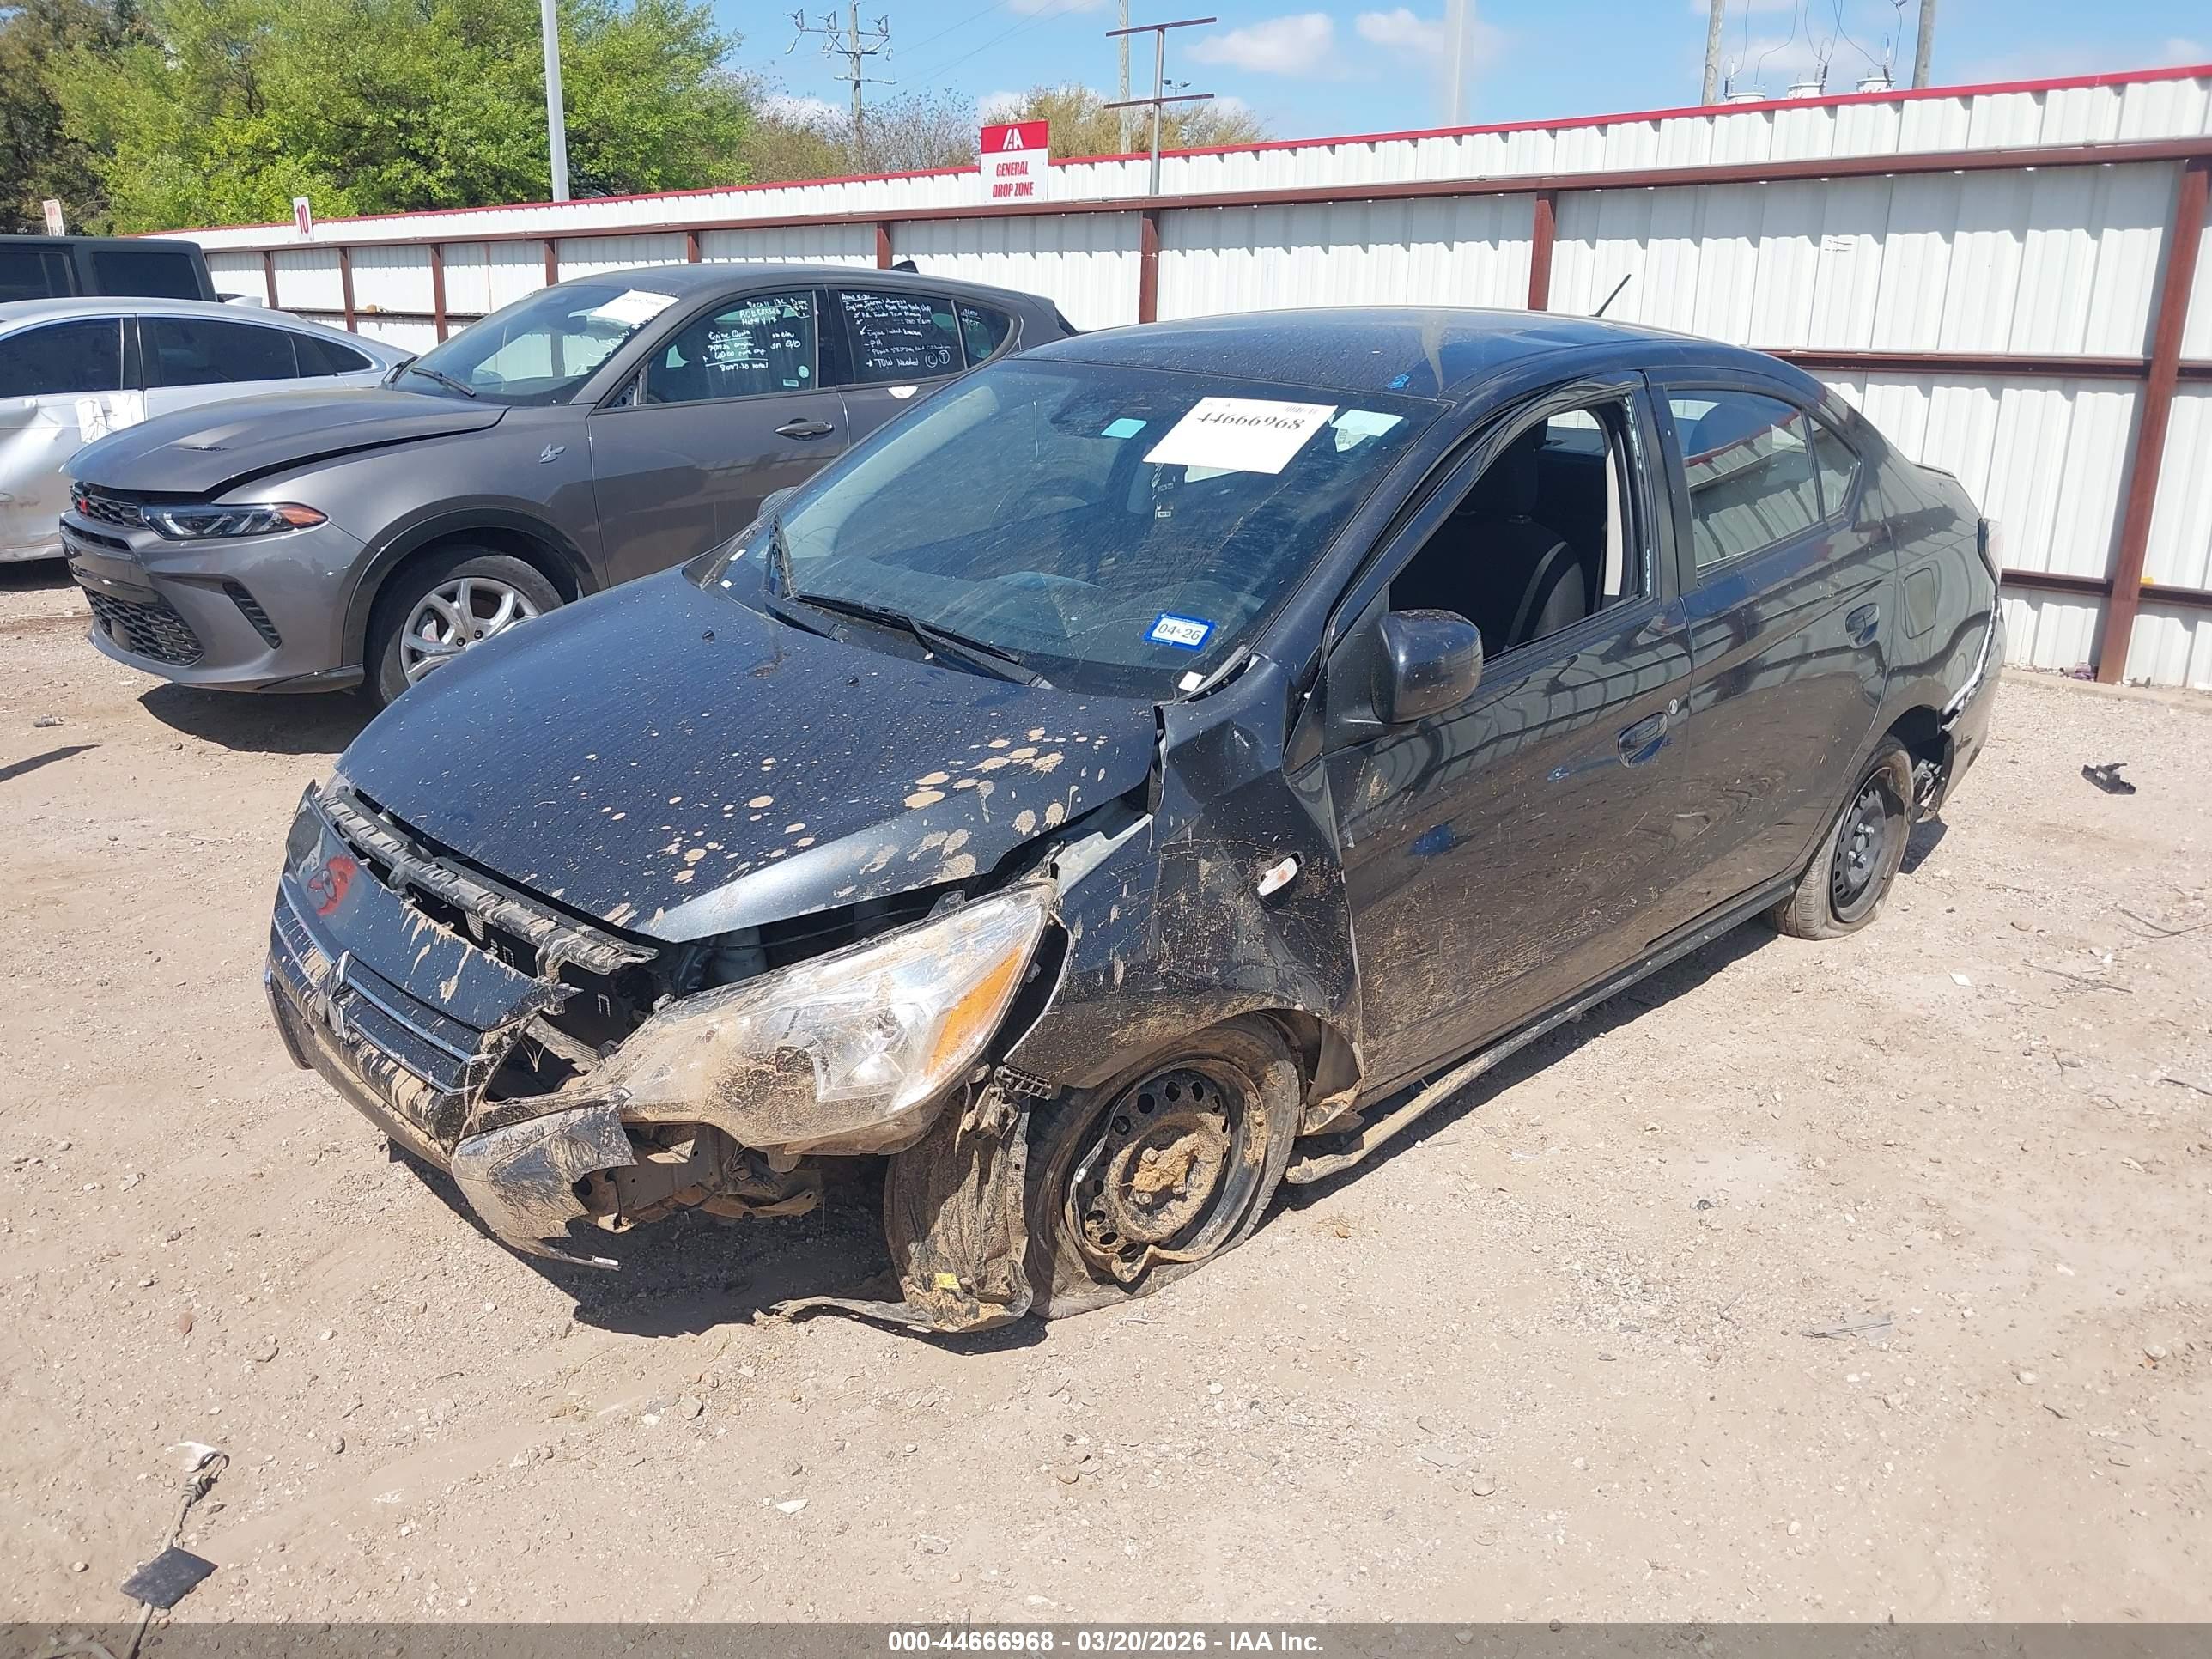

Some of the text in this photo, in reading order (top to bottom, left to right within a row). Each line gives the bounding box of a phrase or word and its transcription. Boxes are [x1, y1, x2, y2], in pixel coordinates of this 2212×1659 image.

[996, 161, 1029, 177] GENERAL
[993, 182, 1034, 198] DROP ZONE
[296, 204, 309, 234] 10
[874, 358, 893, 368] TOW
[1197, 412, 1306, 430] 44666968
[1158, 623, 1201, 640] 04 26
